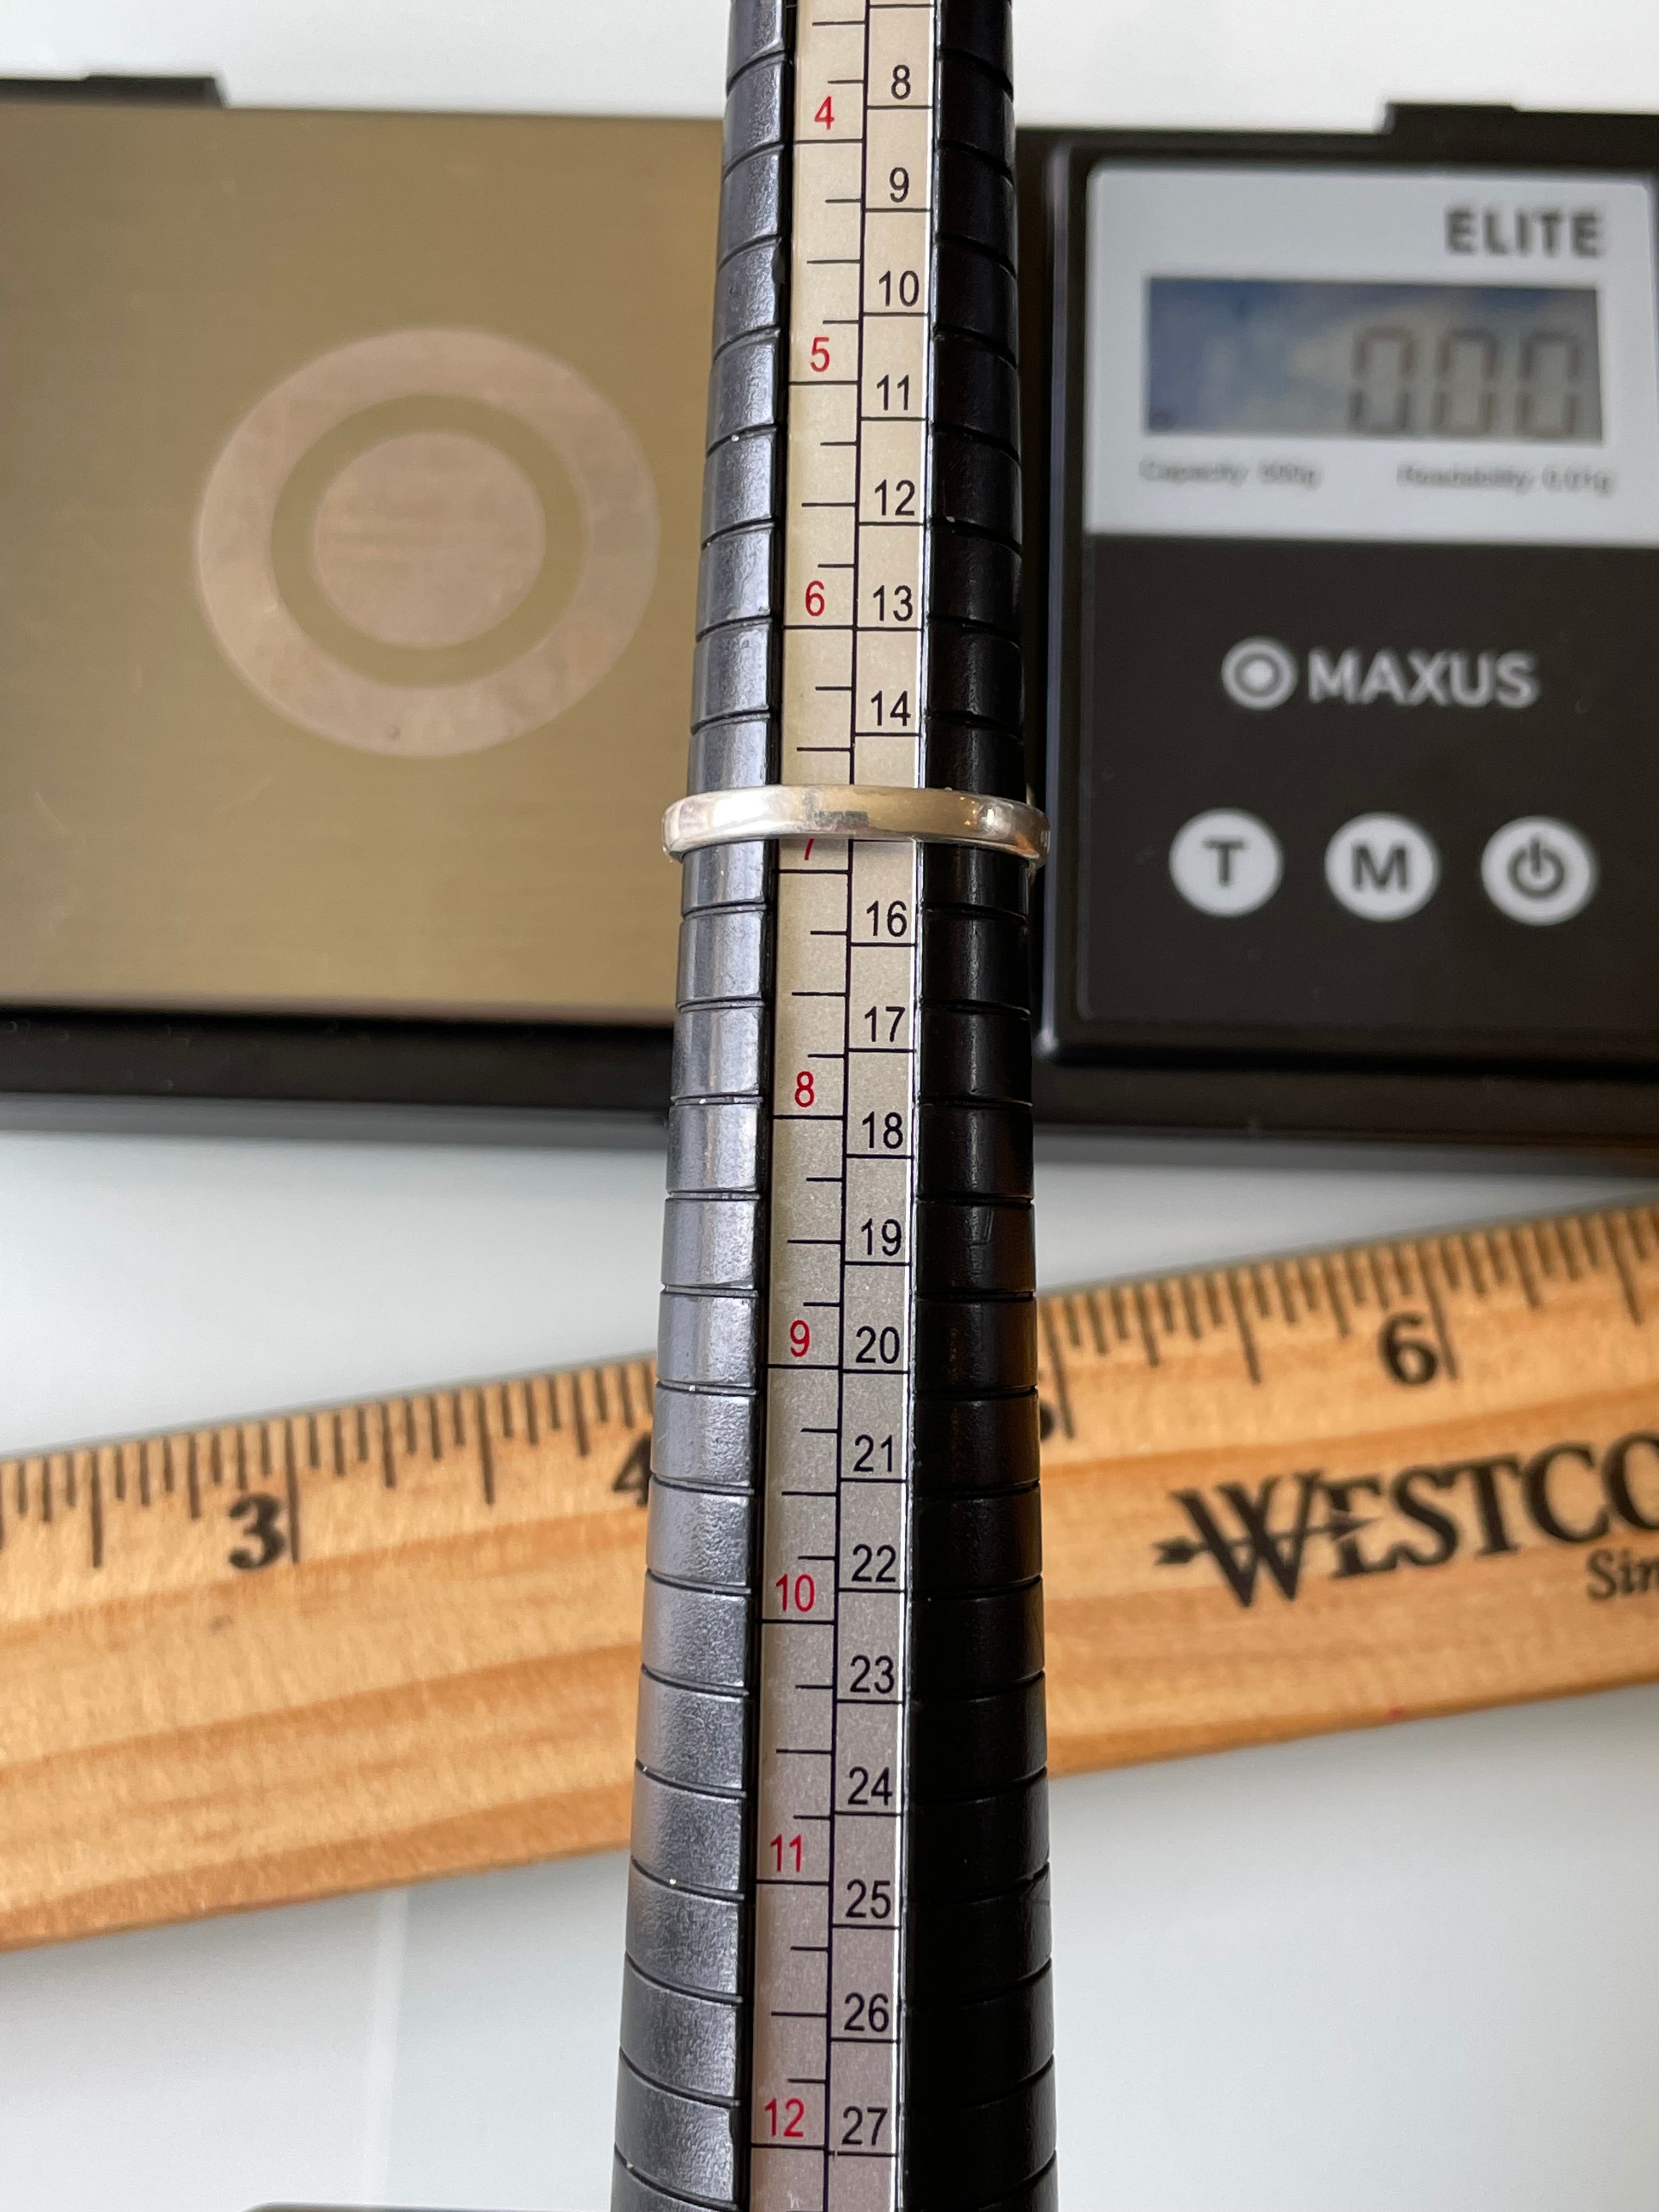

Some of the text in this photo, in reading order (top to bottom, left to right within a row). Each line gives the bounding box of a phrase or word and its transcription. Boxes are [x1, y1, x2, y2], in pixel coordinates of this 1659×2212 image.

[891, 64, 911, 100] 8
[814, 94, 835, 130] 4
[889, 167, 910, 203] 9
[1444, 207, 1605, 257] ELITE
[878, 270, 919, 307] 10
[810, 335, 831, 373] 5
[876, 374, 909, 411] 11
[874, 479, 915, 516] 12
[805, 579, 826, 617] 6
[873, 585, 913, 622] 13
[1308, 647, 1538, 709] MAXUS
[871, 690, 911, 727] 14
[1202, 838, 1246, 888] T
[1351, 842, 1410, 893] M
[866, 900, 907, 938] 16
[864, 1006, 906, 1043] 17
[794, 1070, 815, 1108] 8
[862, 1111, 904, 1149] 18
[861, 1218, 902, 1257] 19
[789, 1319, 811, 1358] 9
[855, 1325, 900, 1364] 20
[1378, 1313, 1438, 1386] 6
[853, 1434, 893, 1473] 21
[227, 1491, 289, 1571] 3
[851, 1543, 896, 1583] 22
[776, 1573, 816, 1613] 10
[849, 1654, 895, 1695] 23
[847, 1766, 893, 1806] 24
[771, 1834, 803, 1873] 11
[845, 1878, 891, 1920] 25
[844, 1992, 889, 2033] 26
[765, 2097, 805, 2138] 12
[841, 2106, 888, 2146] 27
